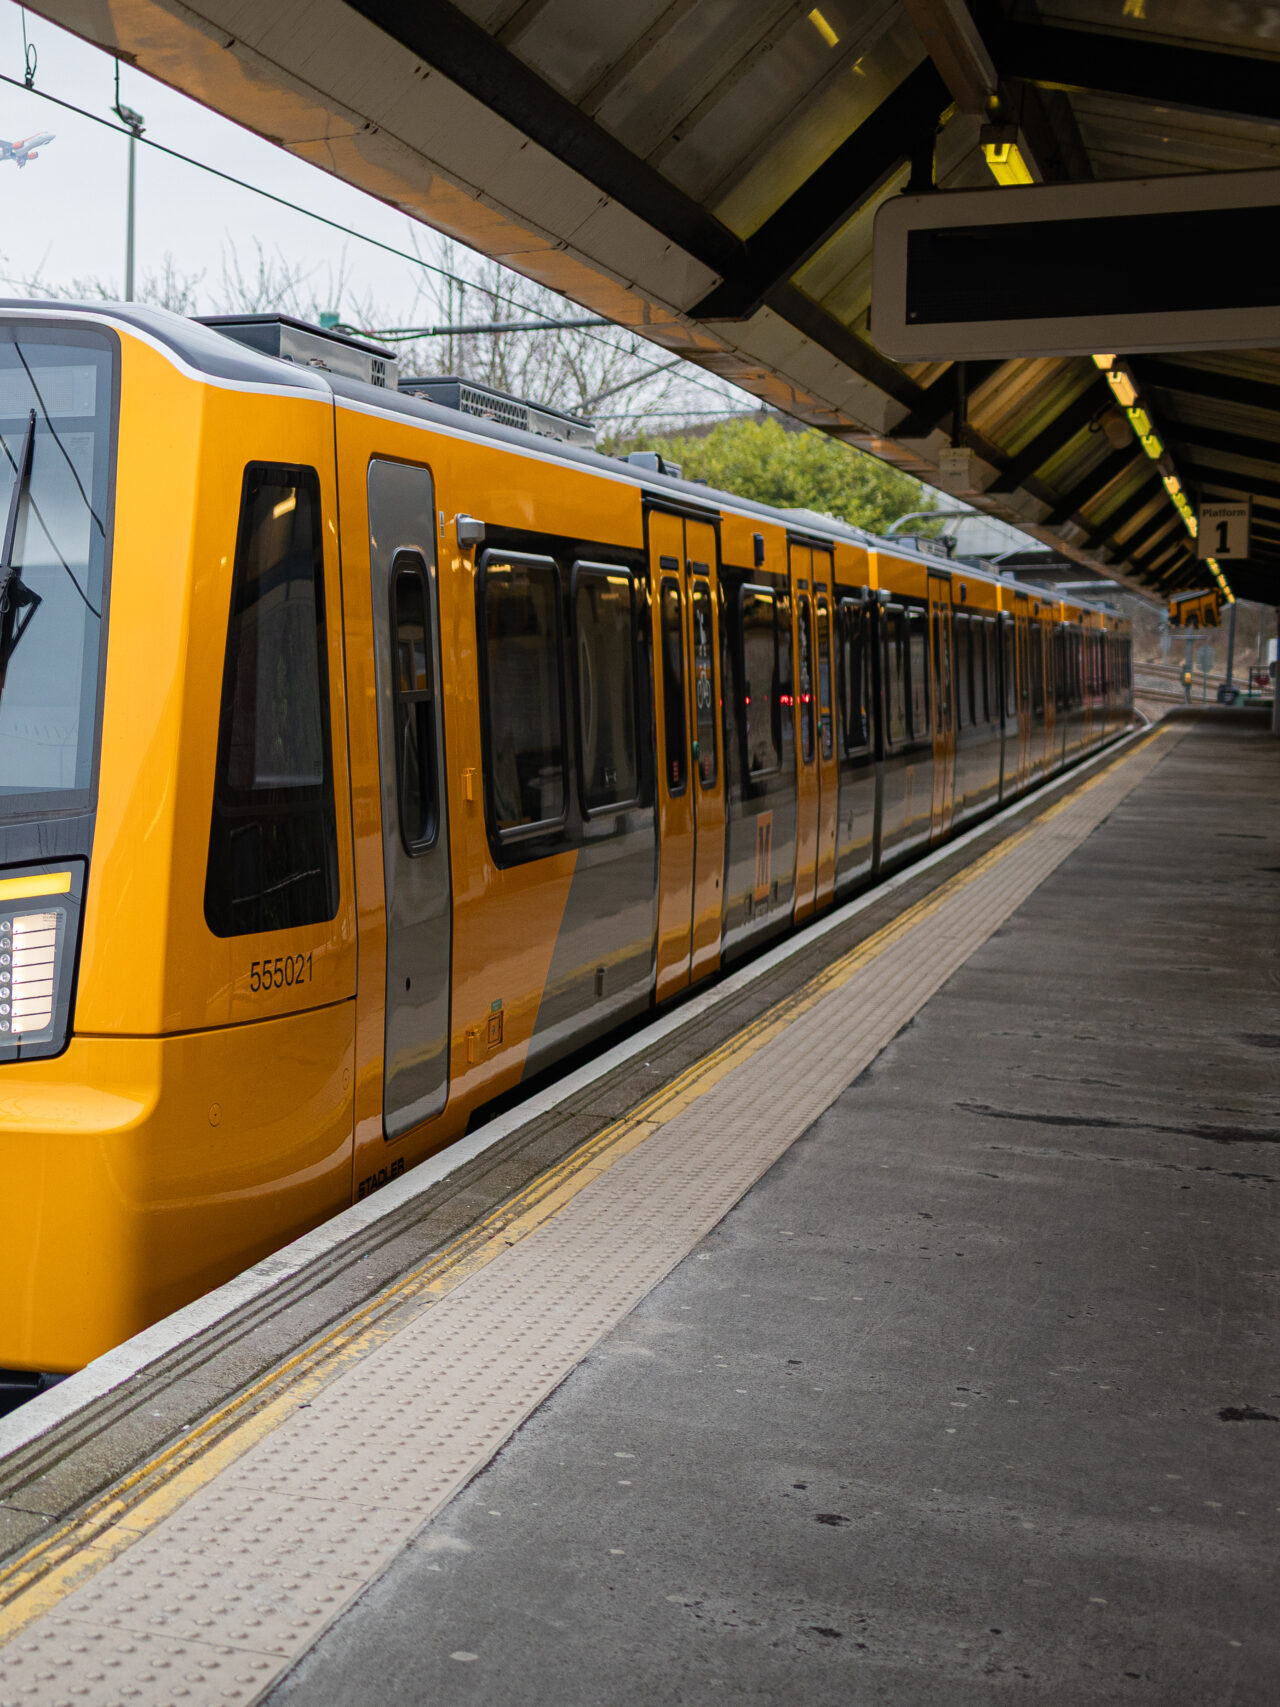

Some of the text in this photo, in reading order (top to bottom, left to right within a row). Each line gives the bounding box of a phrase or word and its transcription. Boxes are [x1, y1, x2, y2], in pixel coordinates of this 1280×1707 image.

[1202, 507, 1247, 518] Platform
[1215, 520, 1231, 554] 1
[250, 952, 313, 992] 555021
[358, 1156, 405, 1199] STADLER
